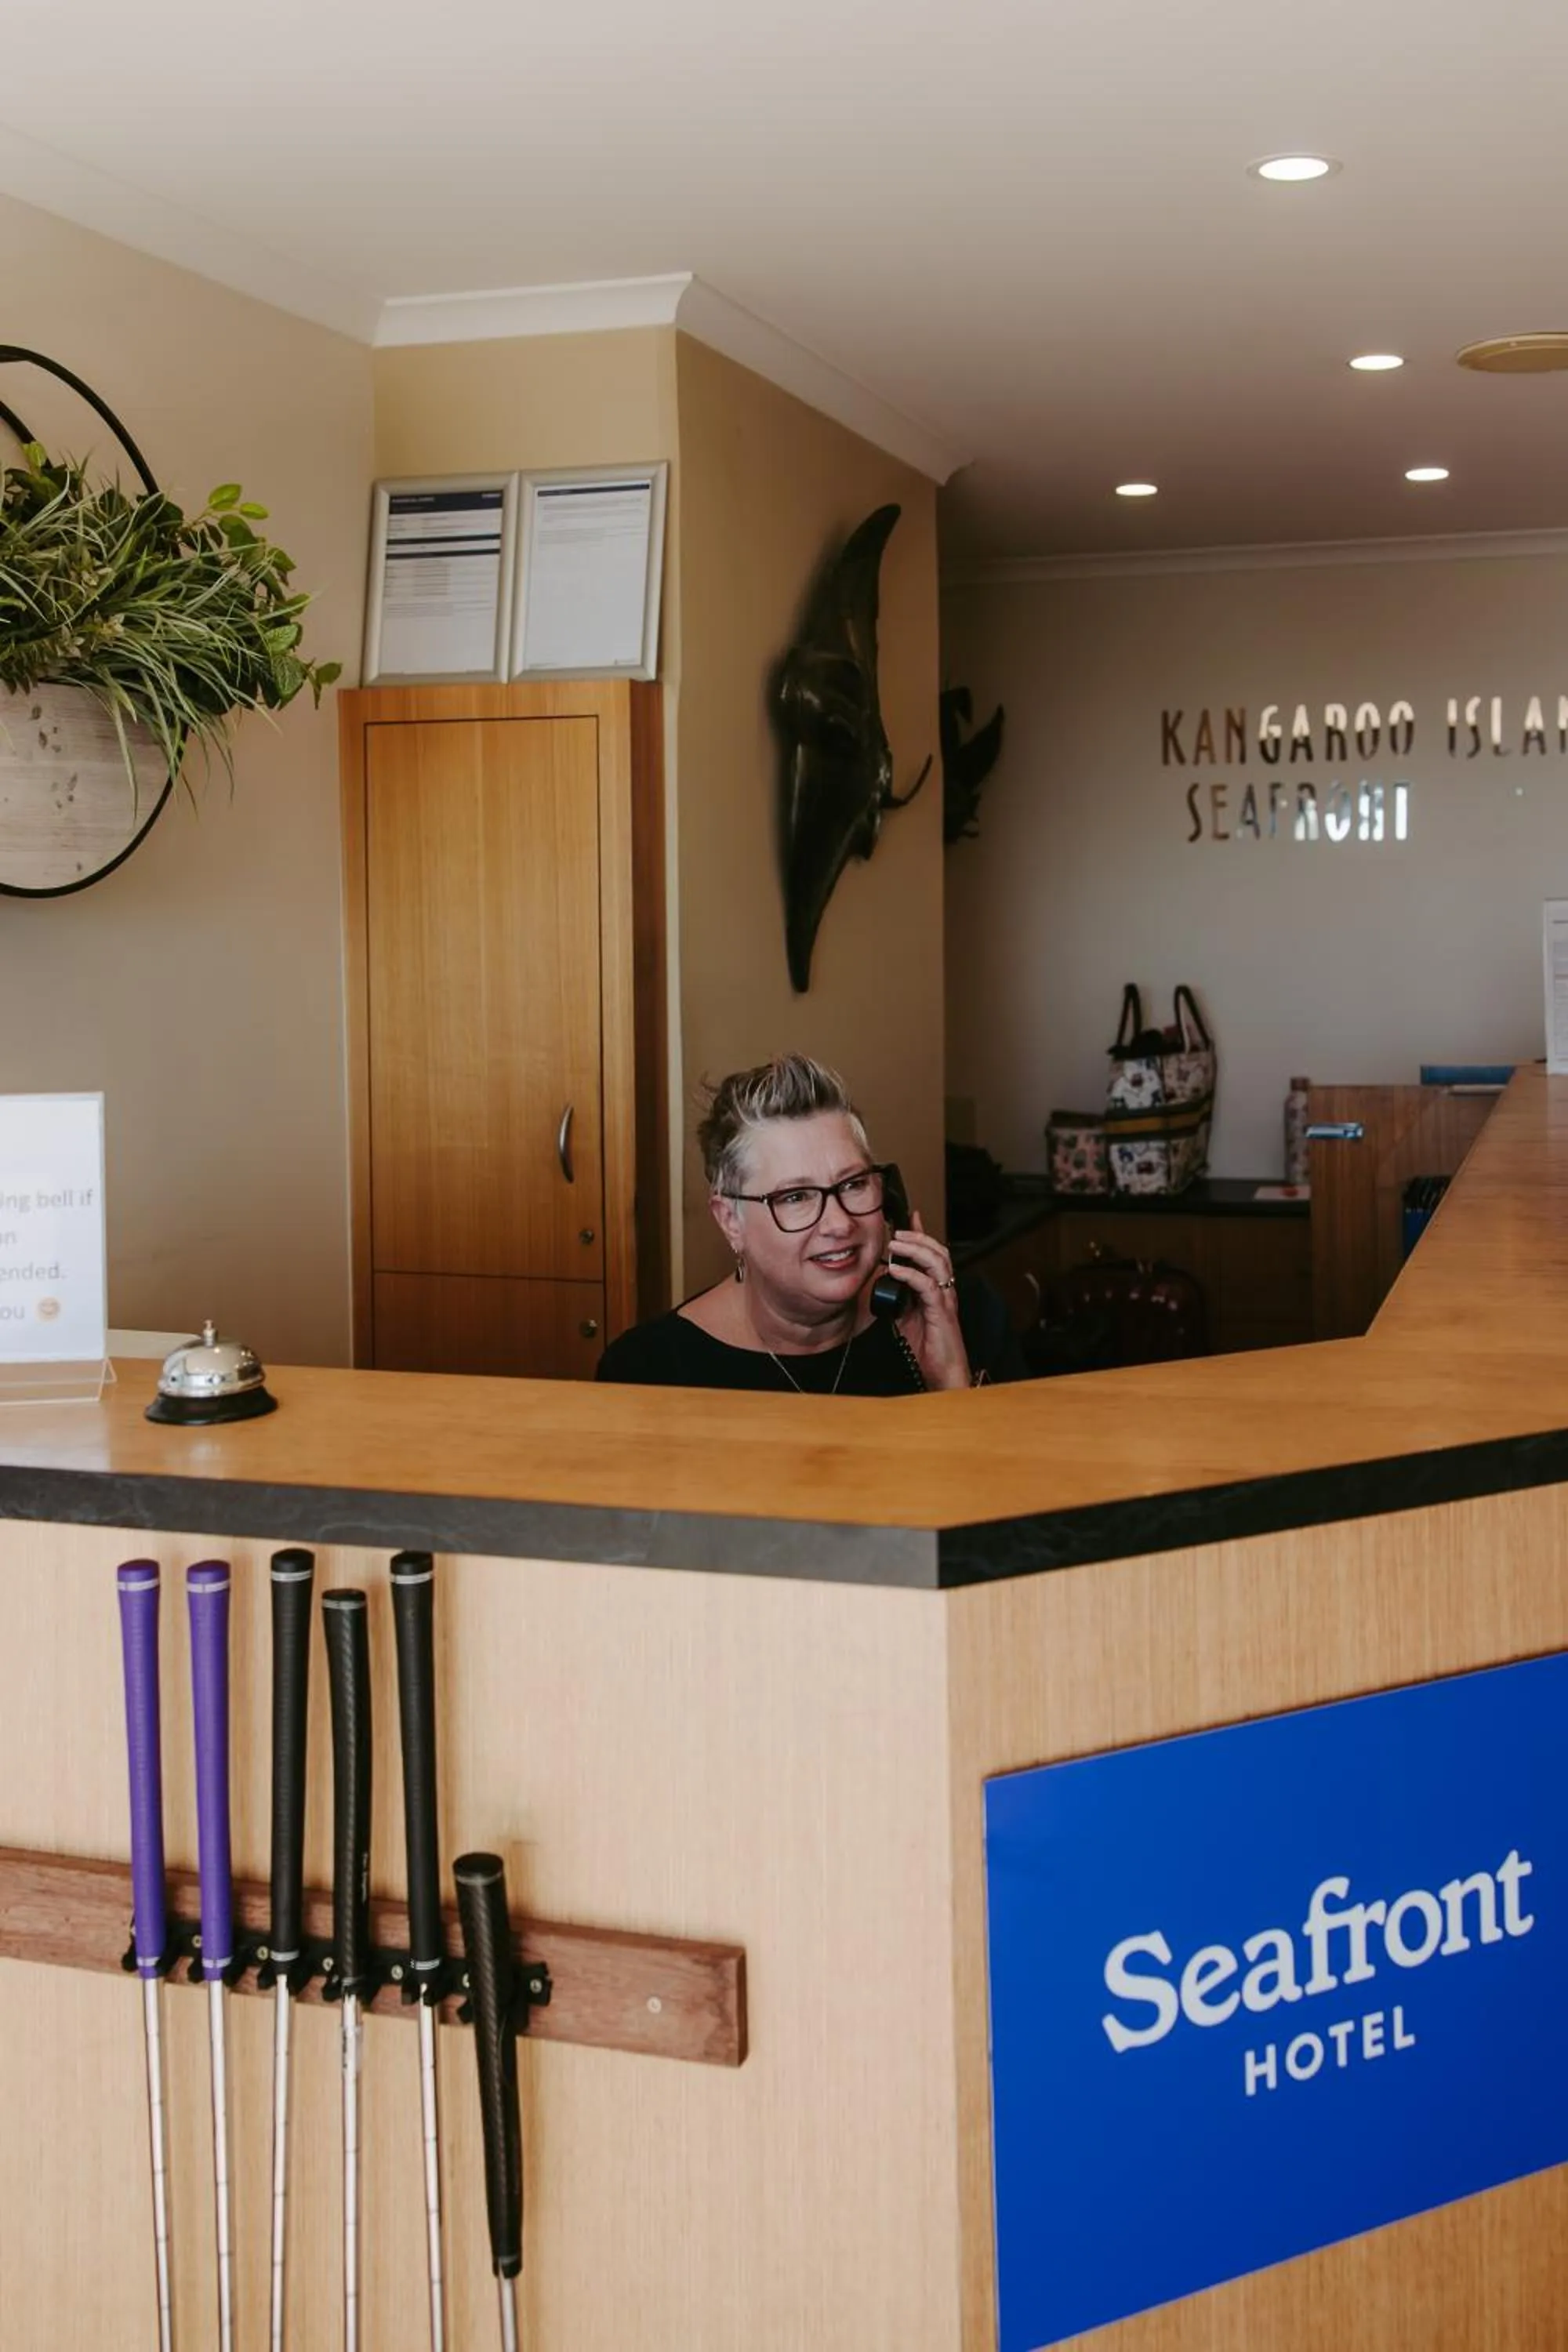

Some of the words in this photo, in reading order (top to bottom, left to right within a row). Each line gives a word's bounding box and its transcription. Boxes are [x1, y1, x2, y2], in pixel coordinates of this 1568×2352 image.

[1160, 700, 1415, 767] KANGAROO
[1186, 779, 1410, 843] SEAFRONT
[35, 1189, 73, 1208] bell
[79, 1189, 93, 1207] if
[1102, 1849, 1534, 2053] Seafront
[1244, 2005, 1416, 2096] HOTEL
